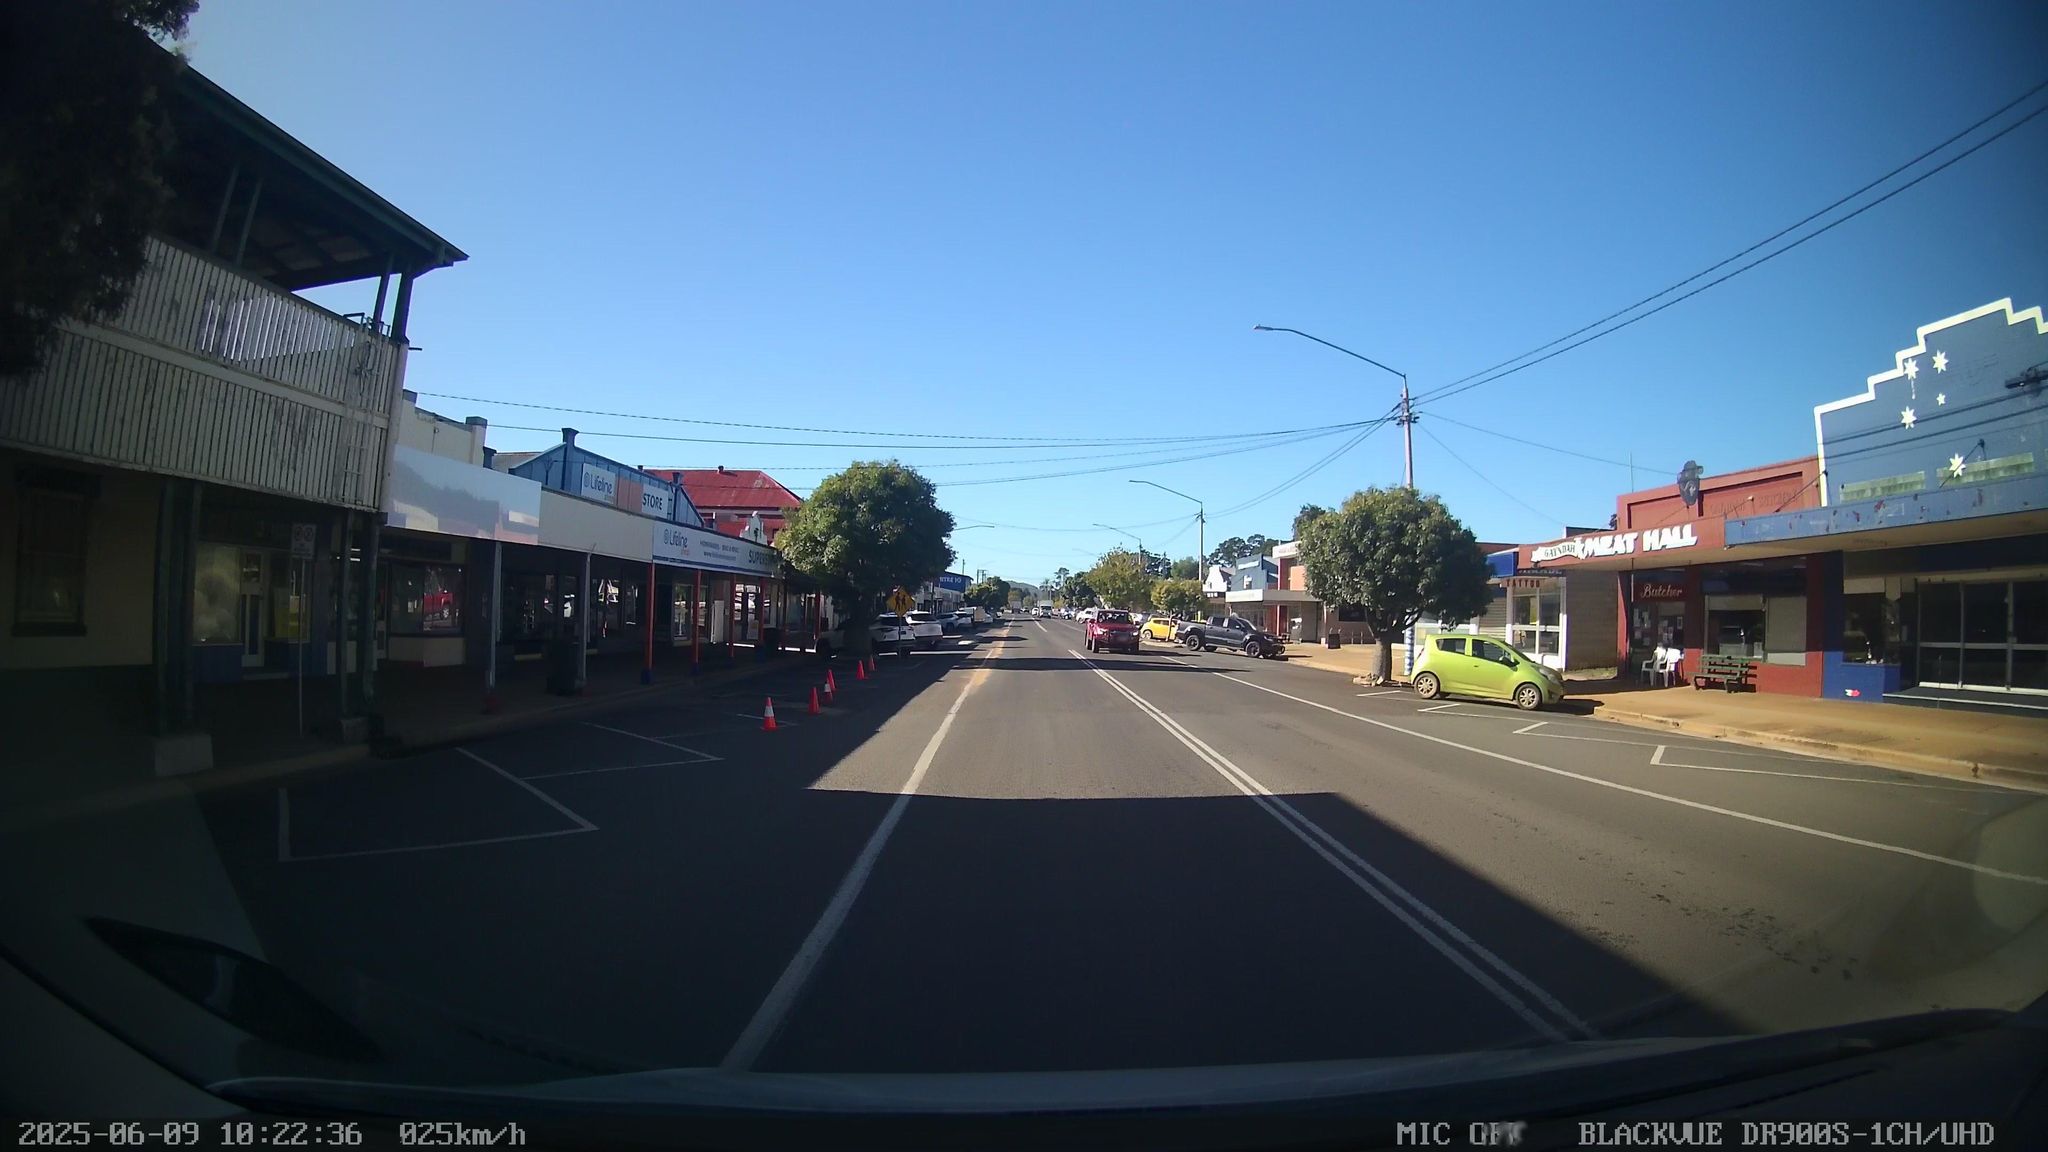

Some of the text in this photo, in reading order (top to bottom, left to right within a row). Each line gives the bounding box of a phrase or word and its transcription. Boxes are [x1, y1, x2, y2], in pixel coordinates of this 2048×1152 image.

[590, 473, 612, 494] Lifeline
[643, 493, 662, 510] STORE
[669, 529, 688, 548] Lifeline
[1585, 524, 1698, 557] MEAT HALL
[1506, 579, 1540, 588] TATTOO
[1641, 584, 1683, 598] Butcher
